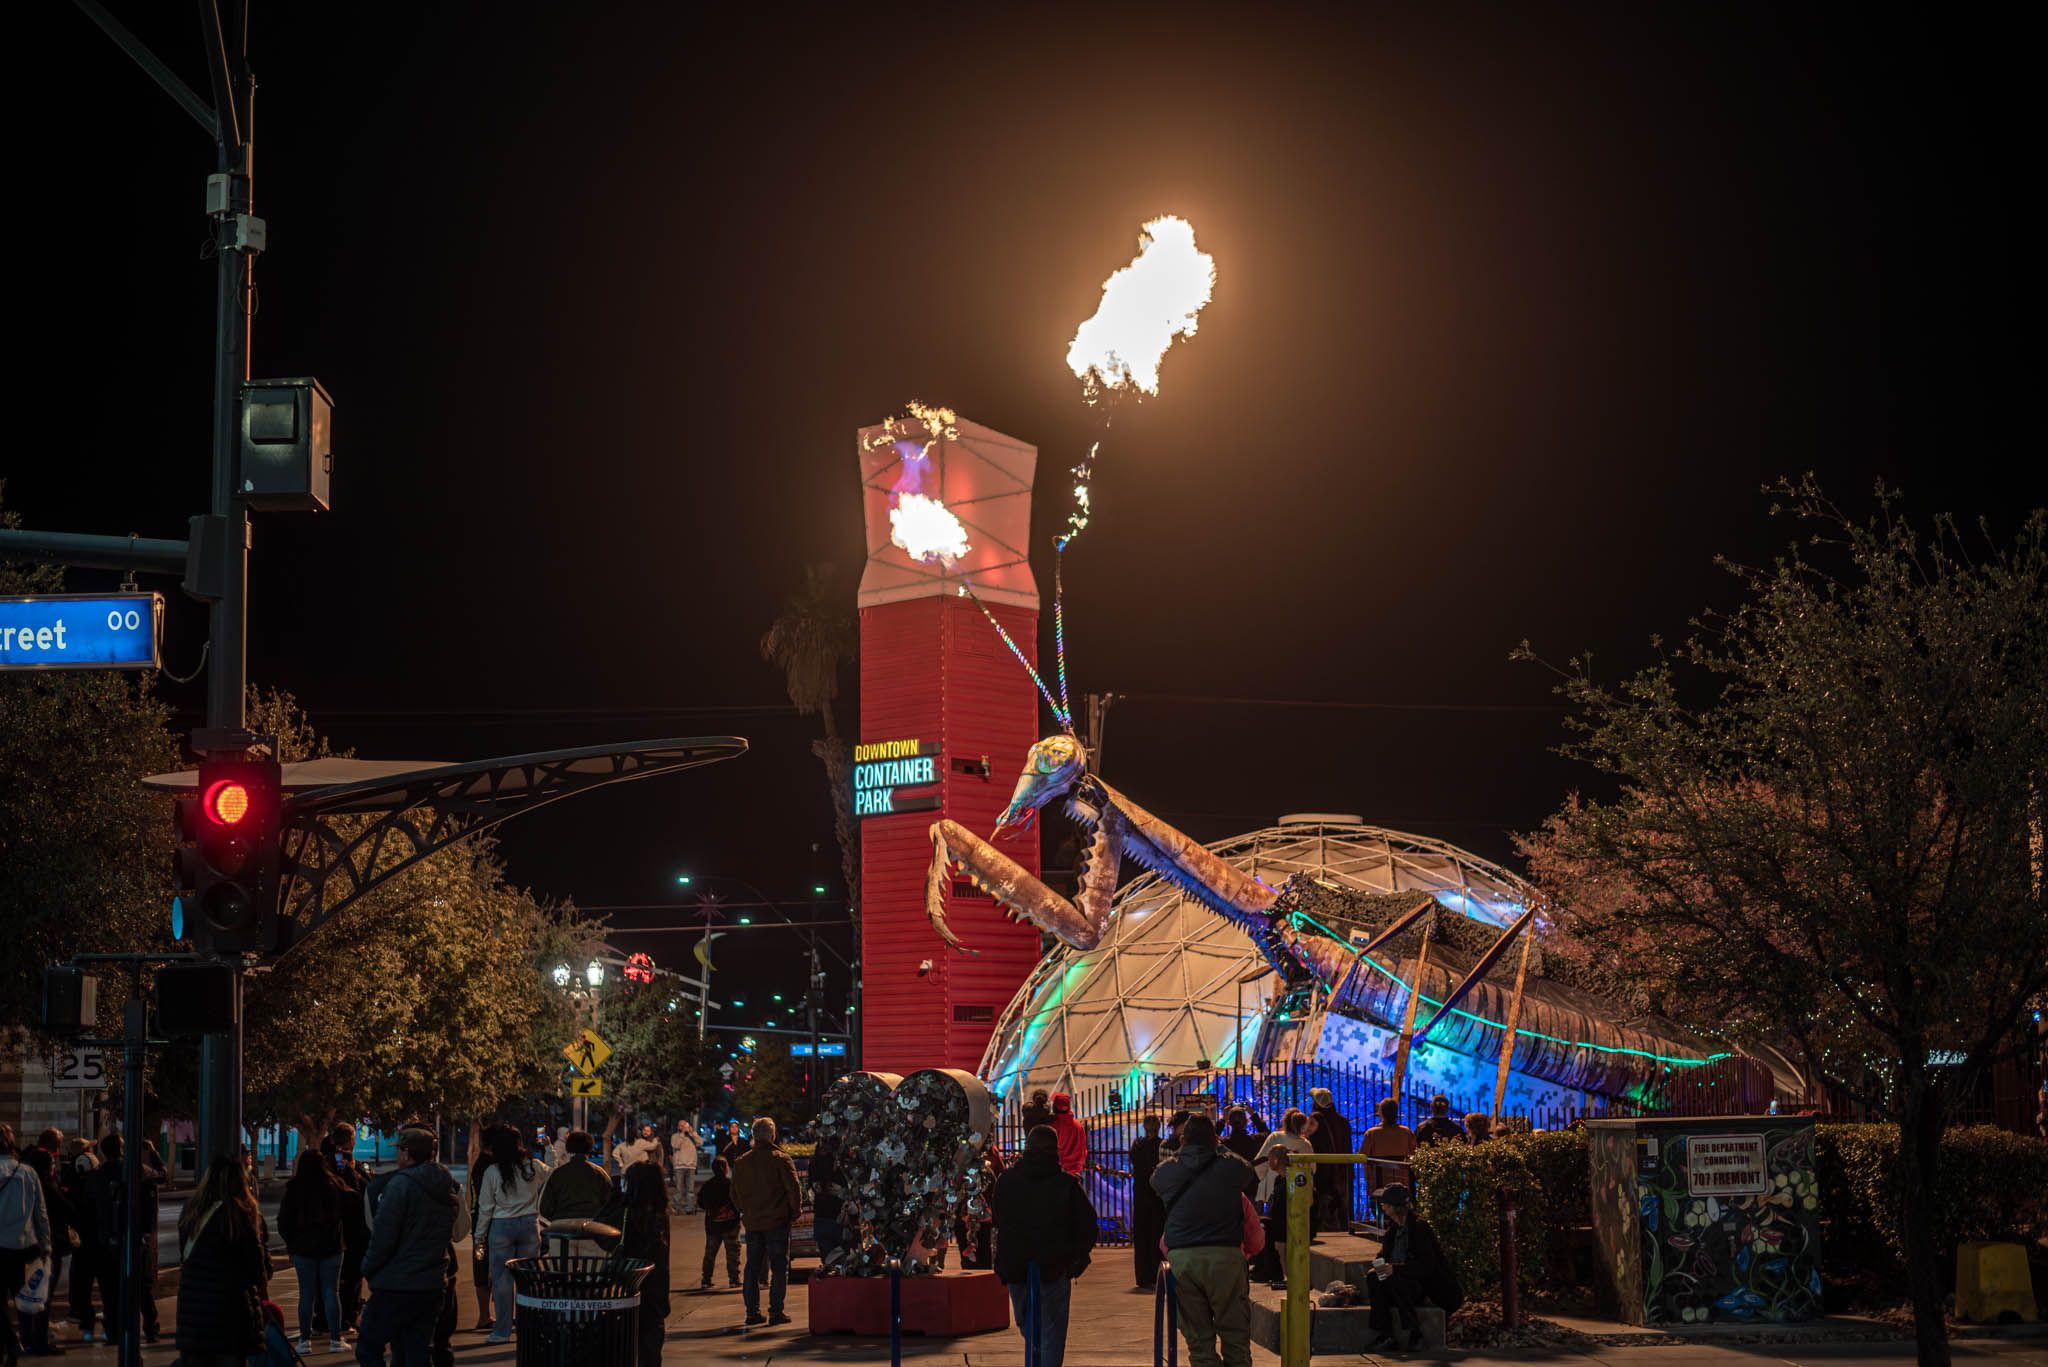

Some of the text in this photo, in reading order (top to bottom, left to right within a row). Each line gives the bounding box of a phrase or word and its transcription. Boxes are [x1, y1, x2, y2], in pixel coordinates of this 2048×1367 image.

[0, 619, 67, 651] reet
[854, 739, 919, 762] DOWNTOWN
[854, 757, 934, 790] CONTAINER
[855, 788, 894, 815] PARK
[62, 1055, 102, 1079] 25
[1694, 1142, 1759, 1153] FIRE DEPARTMENT
[1703, 1155, 1750, 1166] CONNECTION
[1693, 1171, 1761, 1186] 707 FREMONT
[541, 1301, 613, 1309] CITY OF LAS VEGAS
